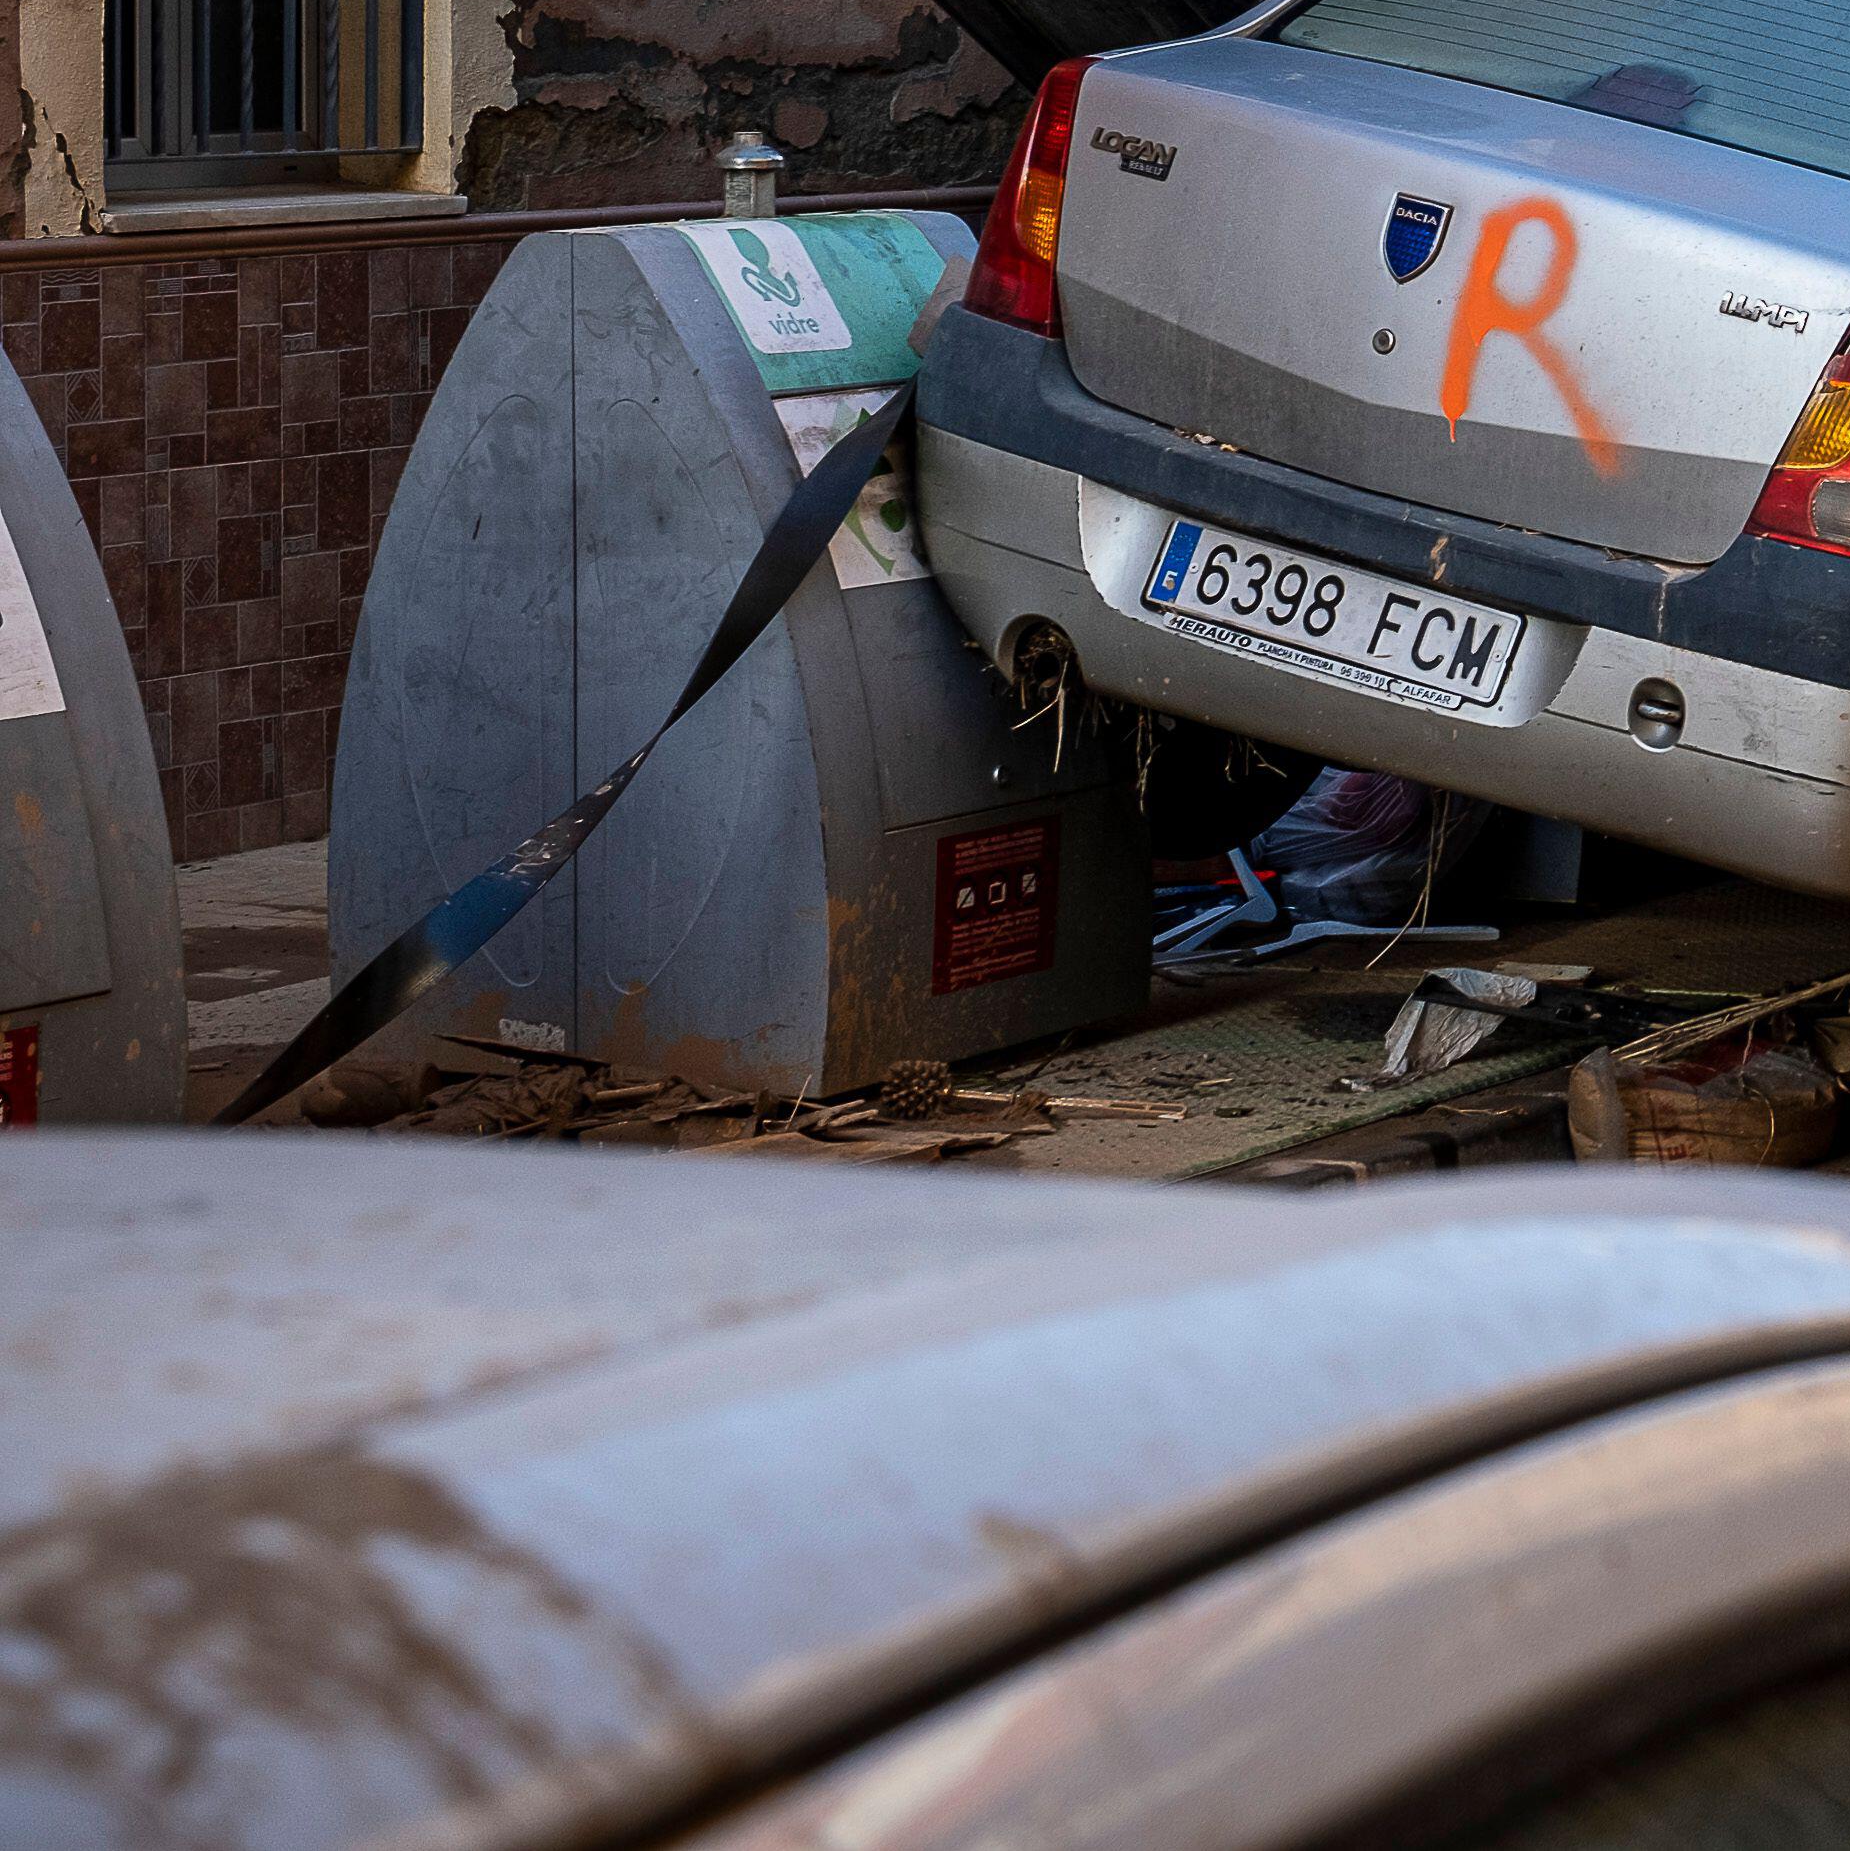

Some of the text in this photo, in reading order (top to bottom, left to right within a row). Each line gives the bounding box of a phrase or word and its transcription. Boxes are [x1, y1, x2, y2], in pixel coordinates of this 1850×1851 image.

[1090, 126, 1178, 166] LOGAN
[1396, 207, 1437, 226] DACIA
[768, 311, 819, 335] vidre
[1440, 195, 1619, 482] R
[1196, 543, 1346, 637] 6398
[1366, 592, 1502, 688] FCM
[1171, 617, 1252, 649] HERAUTO
[1402, 684, 1451, 706] ALFAFAR
